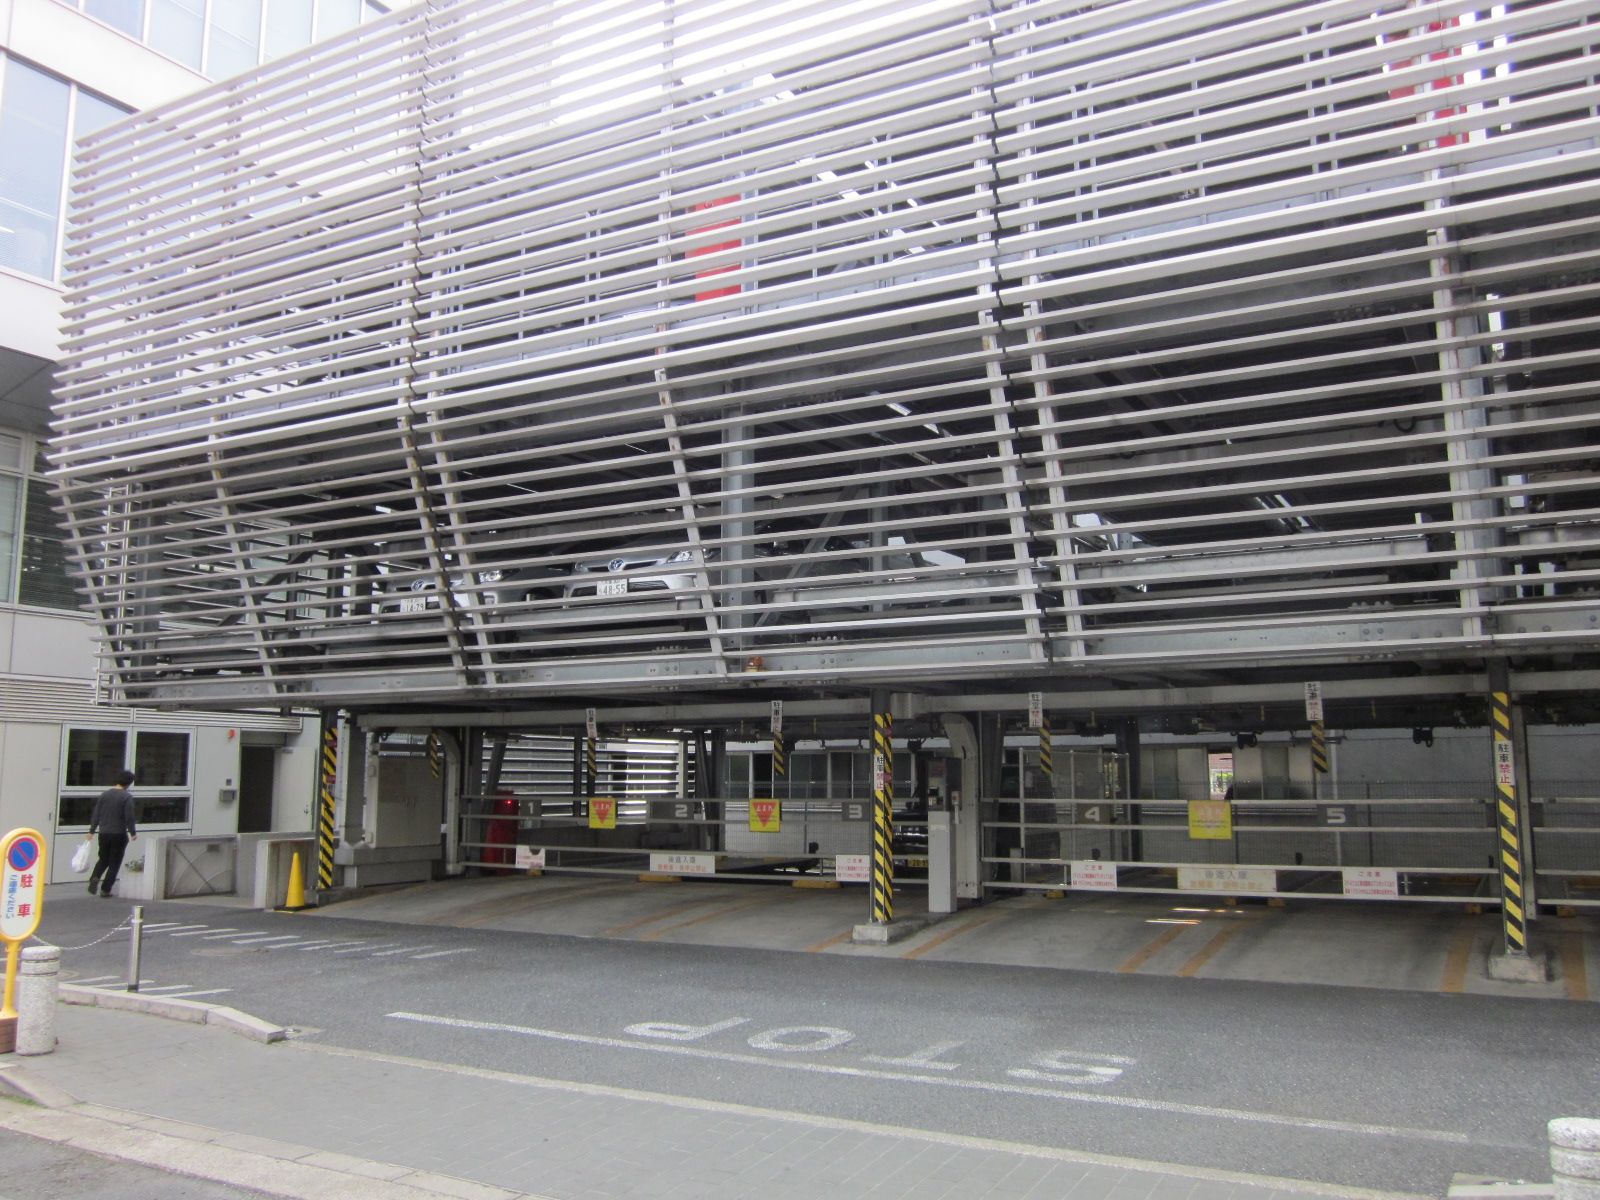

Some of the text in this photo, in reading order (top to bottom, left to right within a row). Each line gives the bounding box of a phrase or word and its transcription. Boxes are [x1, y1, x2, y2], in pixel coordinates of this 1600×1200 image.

[1498, 743, 1511, 784] 駐車禁止
[528, 802, 535, 814] 1
[675, 804, 688, 818] 2
[848, 804, 863, 819] 3
[1084, 806, 1100, 822] 4
[1326, 807, 1346, 824] 5
[17, 874, 34, 917] 駐車
[624, 1016, 1137, 1085] STOP
